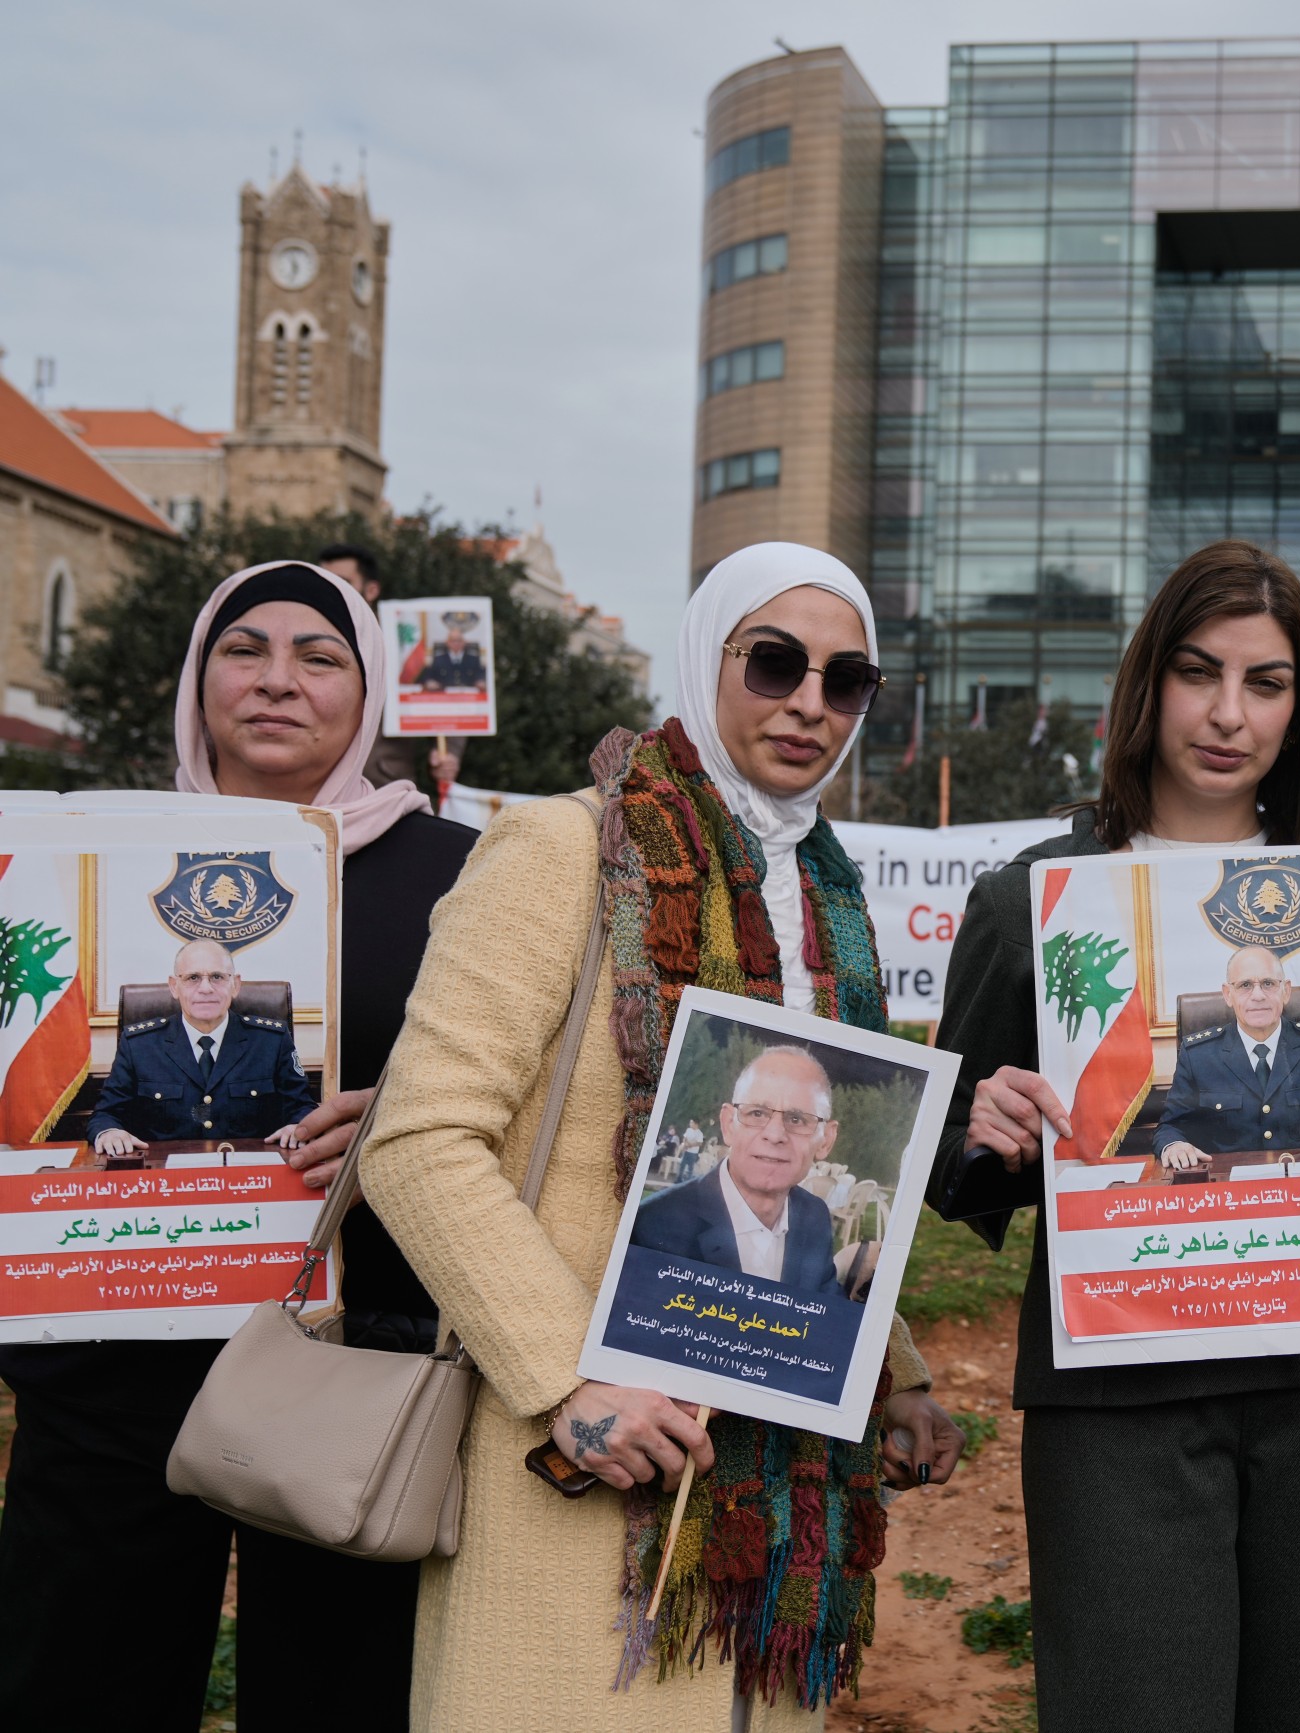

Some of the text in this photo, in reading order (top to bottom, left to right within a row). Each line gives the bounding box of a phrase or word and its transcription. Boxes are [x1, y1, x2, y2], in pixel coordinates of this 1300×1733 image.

[878, 850, 908, 886] in
[177, 915, 273, 939] GENERAL SECURITY
[1226, 925, 1271, 945] GENERAL
[86, 1182, 117, 1199] العام
[121, 1179, 154, 1198] الأمن
[176, 1178, 225, 1193] المتقاعد
[229, 1176, 272, 1193] النقيب
[31, 1183, 82, 1204] اللبناني
[1188, 1190, 1221, 1213] الأمن
[1239, 1188, 1288, 1205] المتقاعد
[1104, 1199, 1151, 1221] اللبناني
[1155, 1196, 1184, 1215] العام
[57, 1206, 260, 1245] أحمد علي ضاهر شكر
[1129, 1233, 1170, 1262] شكر
[1175, 1231, 1228, 1259] ضاهر
[1234, 1228, 1269, 1258] علي
[106, 1259, 138, 1274] داخل
[139, 1258, 156, 1273] من
[221, 1253, 256, 1266] الموساد
[5, 1263, 54, 1280] اللبنانية
[57, 1258, 103, 1279] الأراضي
[658, 1266, 693, 1283] اللبناني
[695, 1273, 718, 1287] العام
[718, 1280, 745, 1294] الأمن
[1131, 1276, 1175, 1297] الأراضي
[1177, 1276, 1208, 1291] داخل
[1210, 1276, 1226, 1289] من
[182, 1282, 218, 1300] بتاريخ
[1083, 1280, 1129, 1298] اللبنانية
[758, 1291, 793, 1307] المتقاعد
[794, 1300, 827, 1315] النقيب
[663, 1293, 809, 1340] أحمد علي ضاهر شكر
[1252, 1298, 1287, 1318] بتاريخ
[627, 1312, 660, 1328] اللبنانية
[661, 1323, 693, 1338] الأراضي
[694, 1330, 717, 1343] داخل
[774, 1351, 800, 1365] الموساد
[802, 1357, 834, 1373] اختطفه
[741, 1363, 767, 1378] بتاريخ
